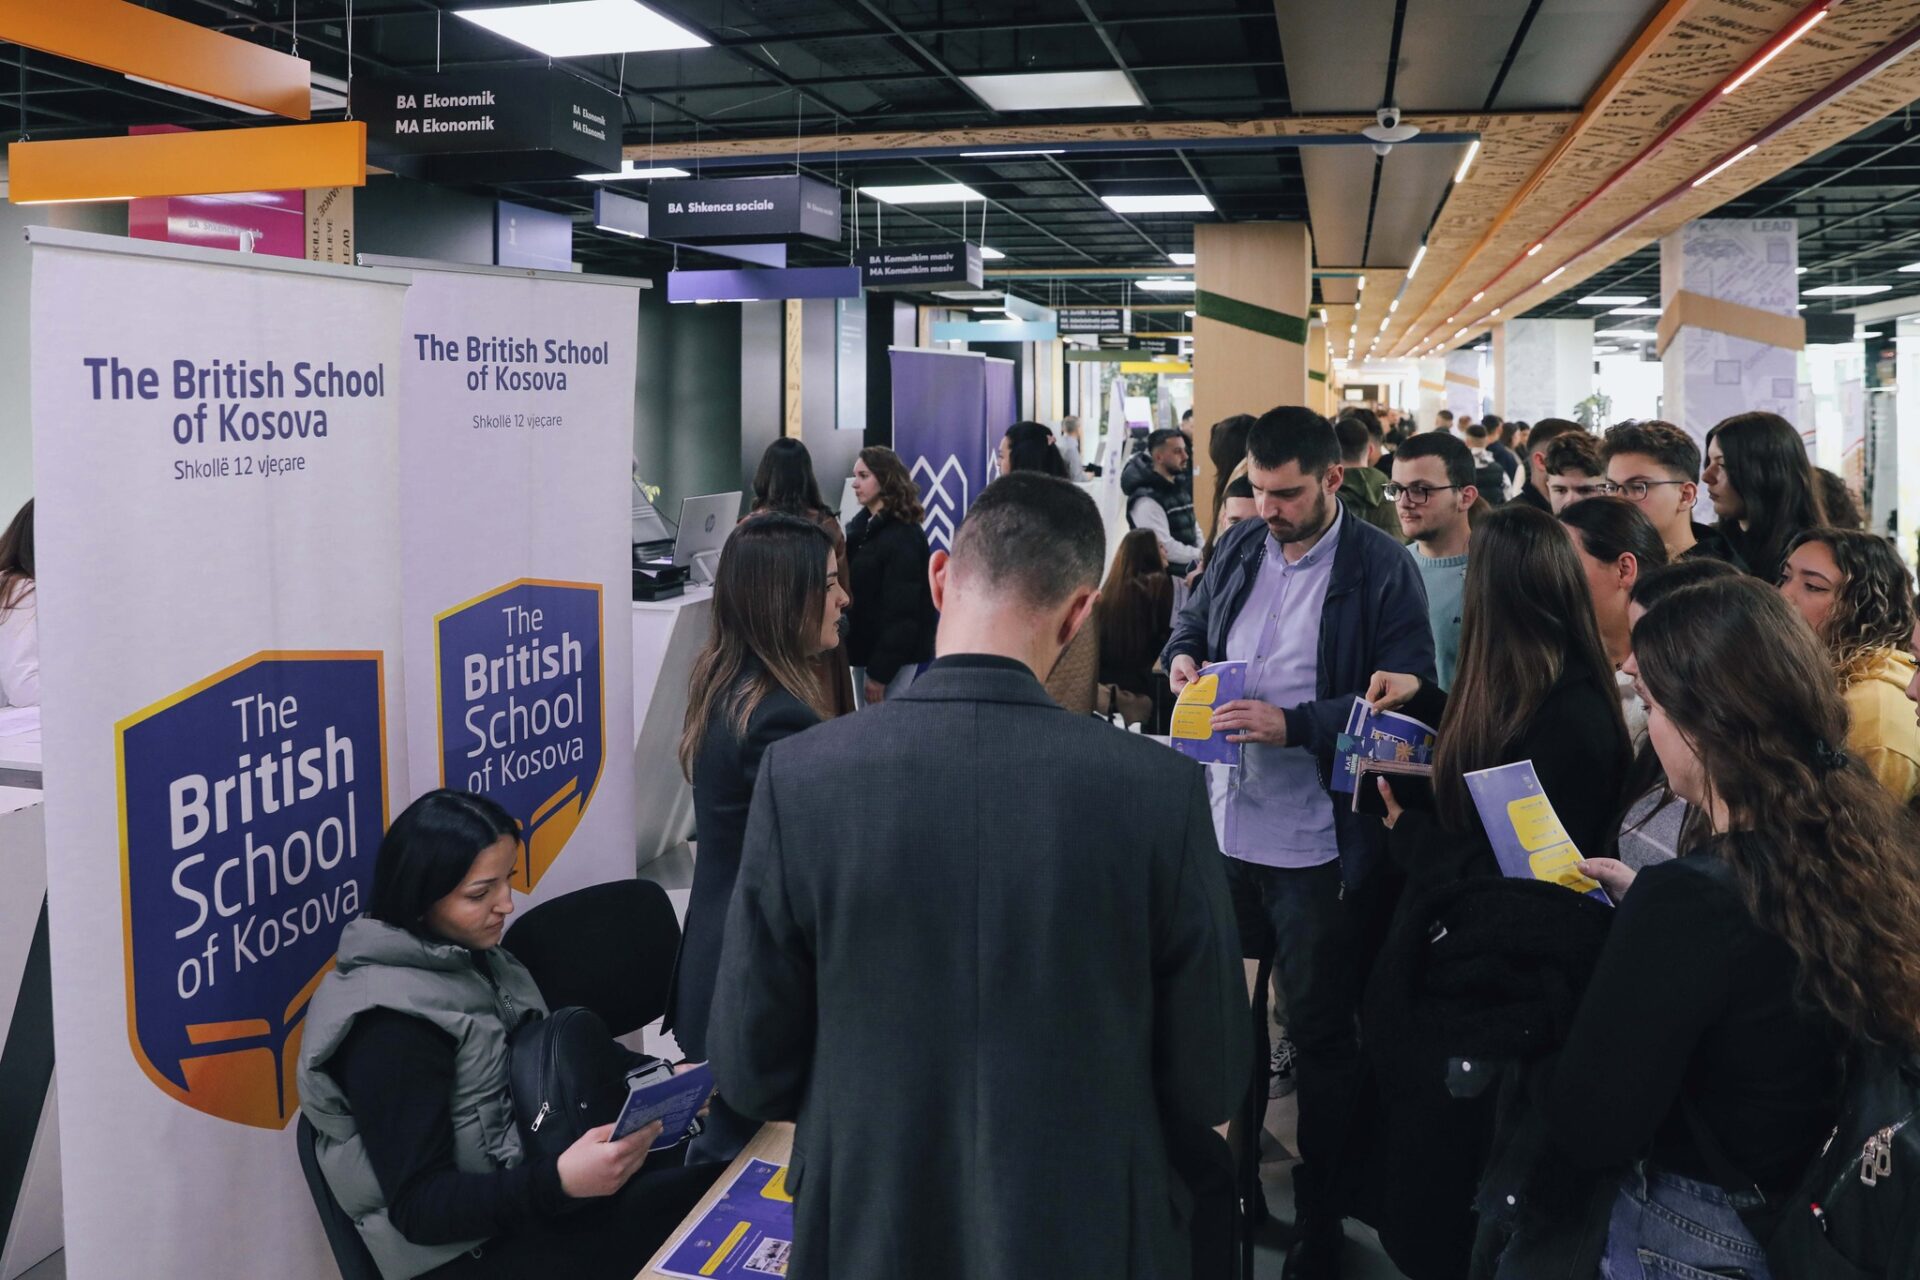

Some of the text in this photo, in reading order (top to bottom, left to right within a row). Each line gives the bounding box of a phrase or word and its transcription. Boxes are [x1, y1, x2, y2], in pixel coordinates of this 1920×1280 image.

[397, 90, 495, 109] BA Ekonomik
[395, 115, 495, 134] MA Ekonomik
[668, 199, 774, 214] BA Shkenca sociale
[1752, 220, 1792, 232] LEAD
[869, 251, 954, 264] BA Komunikim masiv
[869, 263, 954, 276] MA Komunikim masiv
[414, 334, 609, 365] The British School
[83, 357, 385, 400] The British School
[467, 365, 567, 391] of Kosova
[173, 402, 327, 444] of Kosova
[472, 414, 563, 430] Shkollë 12 vjeçare
[174, 454, 305, 480] Shkollë 12 vjeçare
[502, 605, 543, 637] The
[464, 632, 582, 701] British
[232, 693, 298, 743] The
[465, 677, 583, 758] School
[468, 737, 584, 794] of Kosova
[169, 726, 355, 850] British
[171, 790, 357, 940] School
[176, 879, 360, 999] of Kosova
